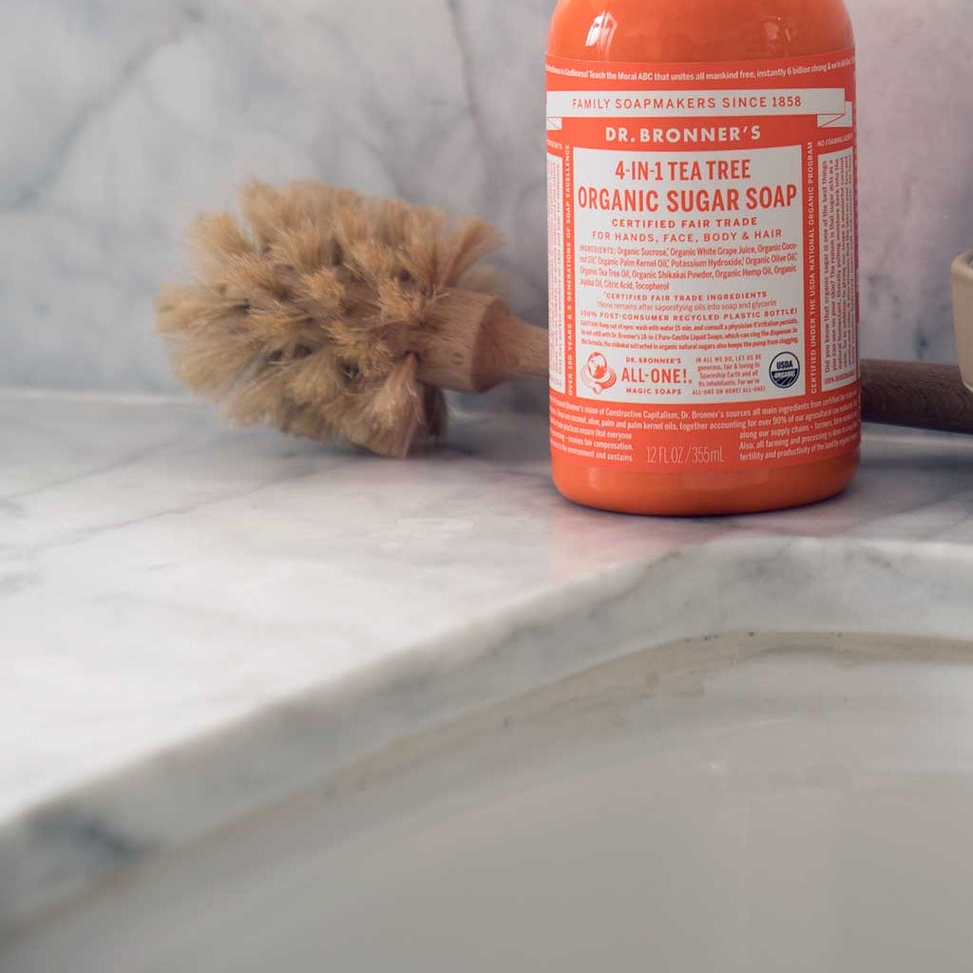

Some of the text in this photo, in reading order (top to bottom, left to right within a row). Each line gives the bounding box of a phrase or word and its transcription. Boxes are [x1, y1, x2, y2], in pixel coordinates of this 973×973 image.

[638, 73, 654, 81] ABC
[654, 73, 670, 81] that
[672, 73, 695, 81] unites
[695, 72, 705, 81] all
[706, 71, 739, 80] mankind
[572, 96, 802, 109] FAMILY SOAPMAKERS SINCE 1858
[605, 125, 761, 143] DR. BRONNER'S
[615, 159, 751, 181] 4-IN-1 TEA TREE
[578, 184, 797, 213] ORGANIC SUGAR SOAP
[807, 186, 815, 226] ORGANIC
[611, 217, 758, 229] CERTIFIED FAIR TRADE
[592, 229, 783, 243] FOR HANDS, FACE, BODY & HAIR
[617, 247, 640, 257] Organic
[670, 248, 696, 258] Organic
[717, 247, 738, 257] Grape
[757, 243, 781, 254] Organic
[598, 257, 619, 267] Organic
[745, 256, 771, 267] Organic
[631, 270, 657, 280] Organic
[715, 270, 741, 280] Organic
[773, 265, 797, 276] Organic
[635, 281, 670, 291] Tocopherol
[651, 294, 671, 302] FAIR
[674, 293, 704, 302] TRADE
[706, 291, 768, 301] INGREDIENTS
[723, 311, 761, 320] PLASTIC
[776, 360, 794, 370] USDA
[621, 367, 687, 384] ALL-ONE!
[606, 408, 641, 419] Constructive
[726, 409, 751, 418] sources
[779, 402, 810, 415] ingredients
[679, 421, 709, 432] together
[710, 420, 747, 431] accounting
[772, 416, 787, 426] 90%
[739, 430, 758, 441] along
[771, 427, 791, 438] supply
[766, 438, 789, 449] farming
[646, 446, 657, 464] 12
[659, 446, 670, 464] FL
[739, 445, 811, 461] fertility and productivity
